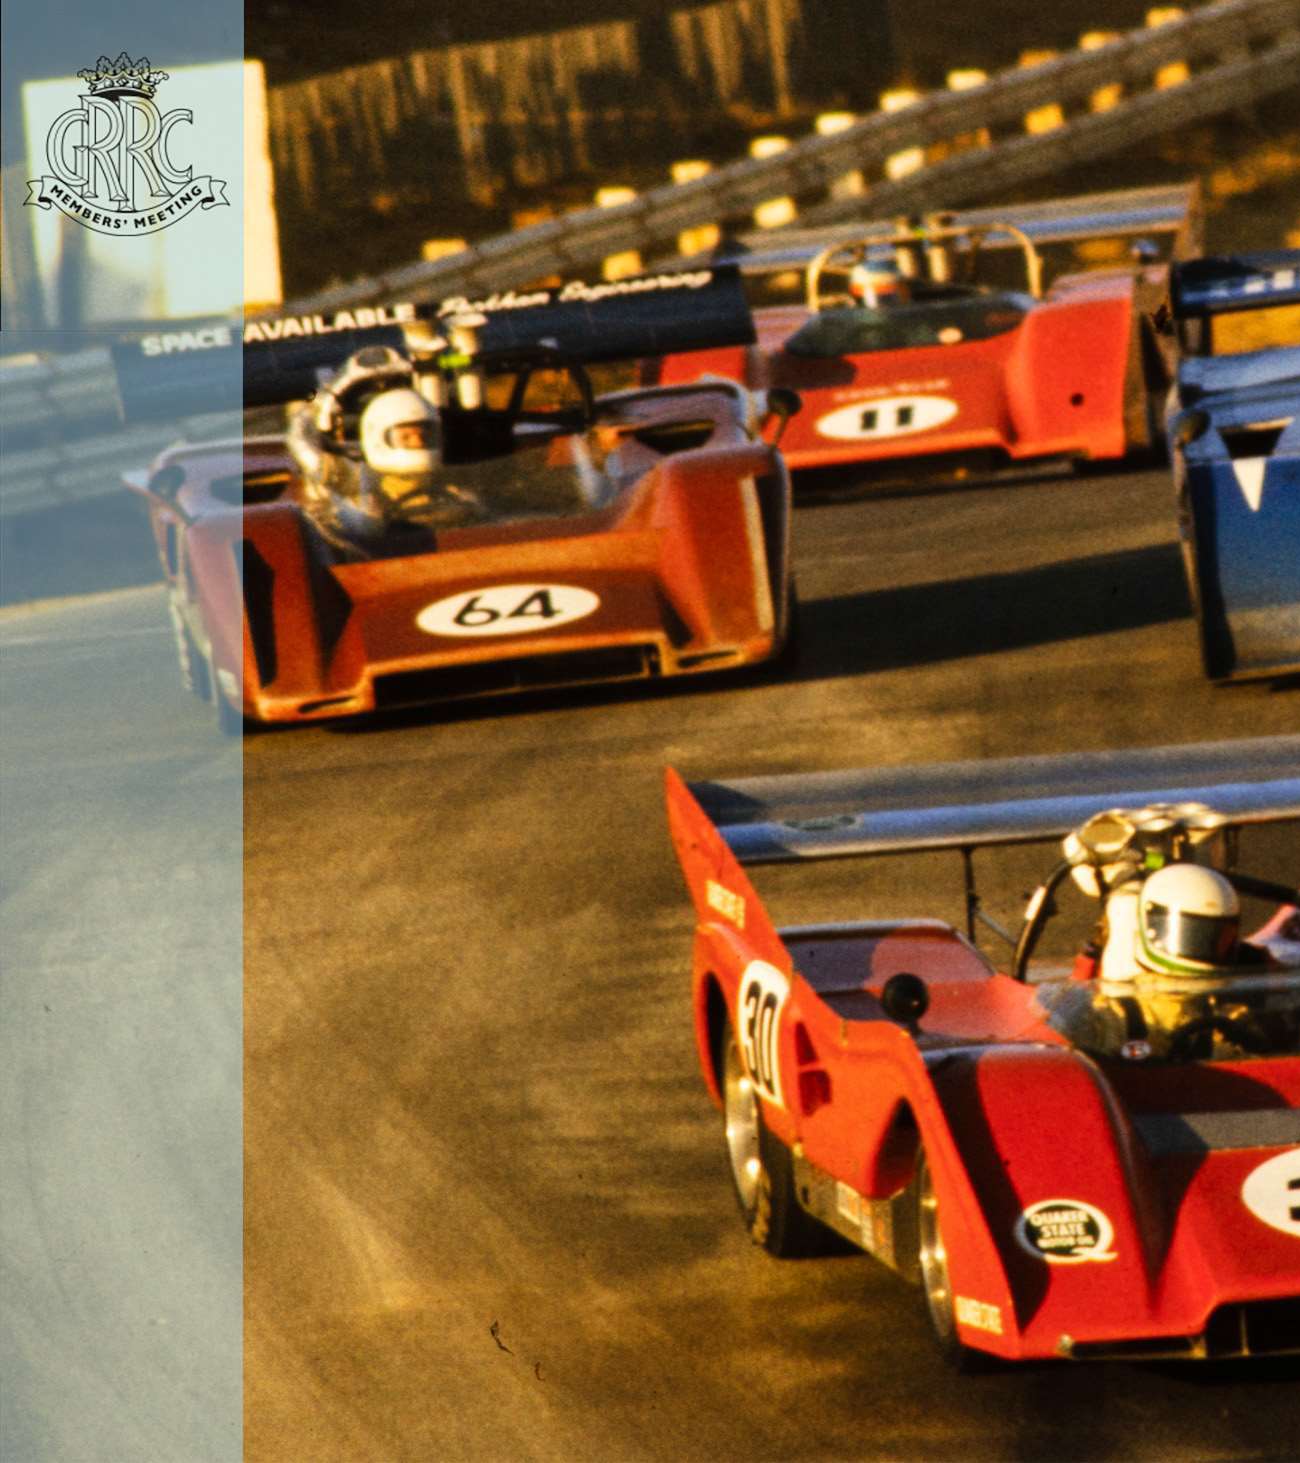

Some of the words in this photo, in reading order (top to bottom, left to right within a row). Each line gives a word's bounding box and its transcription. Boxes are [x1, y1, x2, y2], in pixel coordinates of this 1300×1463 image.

[142, 327, 231, 356] SPACE
[244, 303, 415, 343] AVAILABLE
[861, 406, 914, 430] 11
[453, 588, 563, 627] 64
[746, 980, 778, 1095] 30
[1040, 1222, 1085, 1238] STATE
